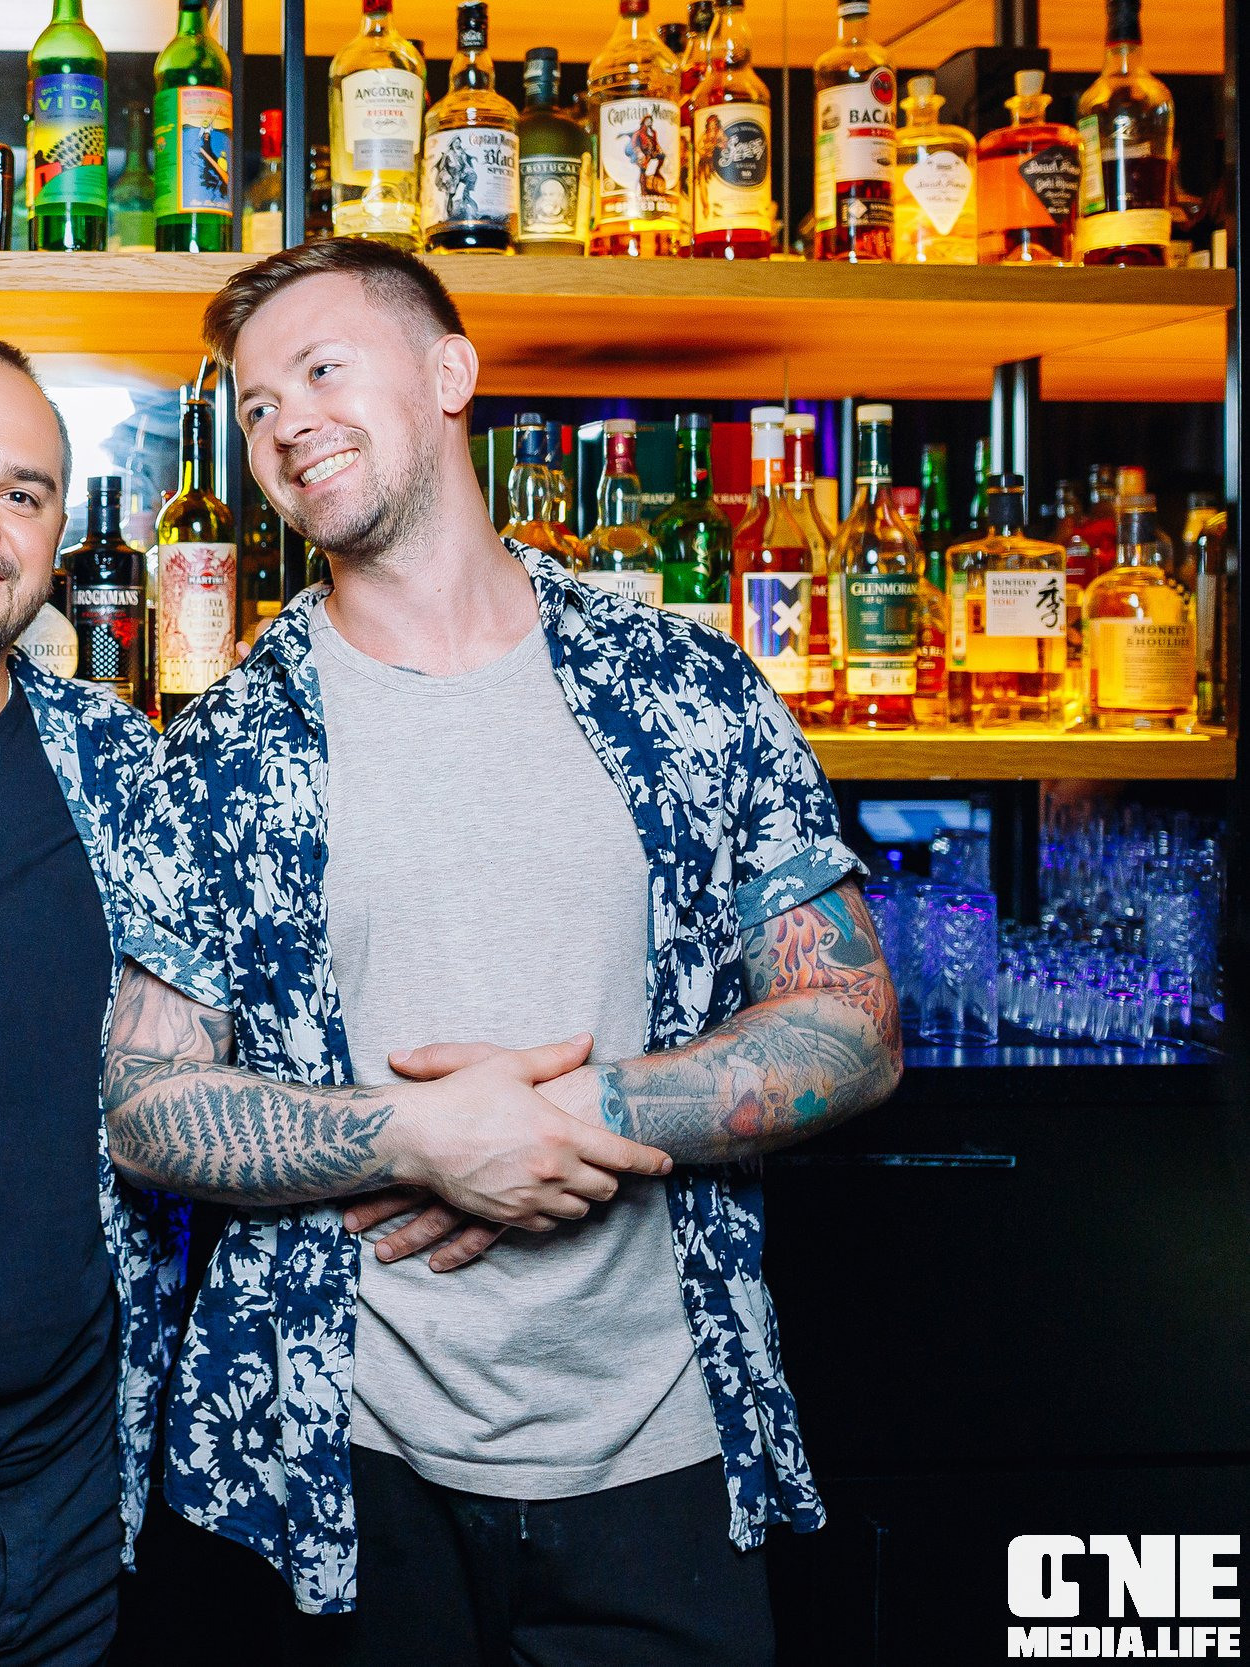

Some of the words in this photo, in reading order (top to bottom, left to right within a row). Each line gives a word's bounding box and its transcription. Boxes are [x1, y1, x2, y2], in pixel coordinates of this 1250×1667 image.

[37, 95, 103, 112] VIDA
[877, 463, 890, 476] 14
[616, 580, 637, 590] THE
